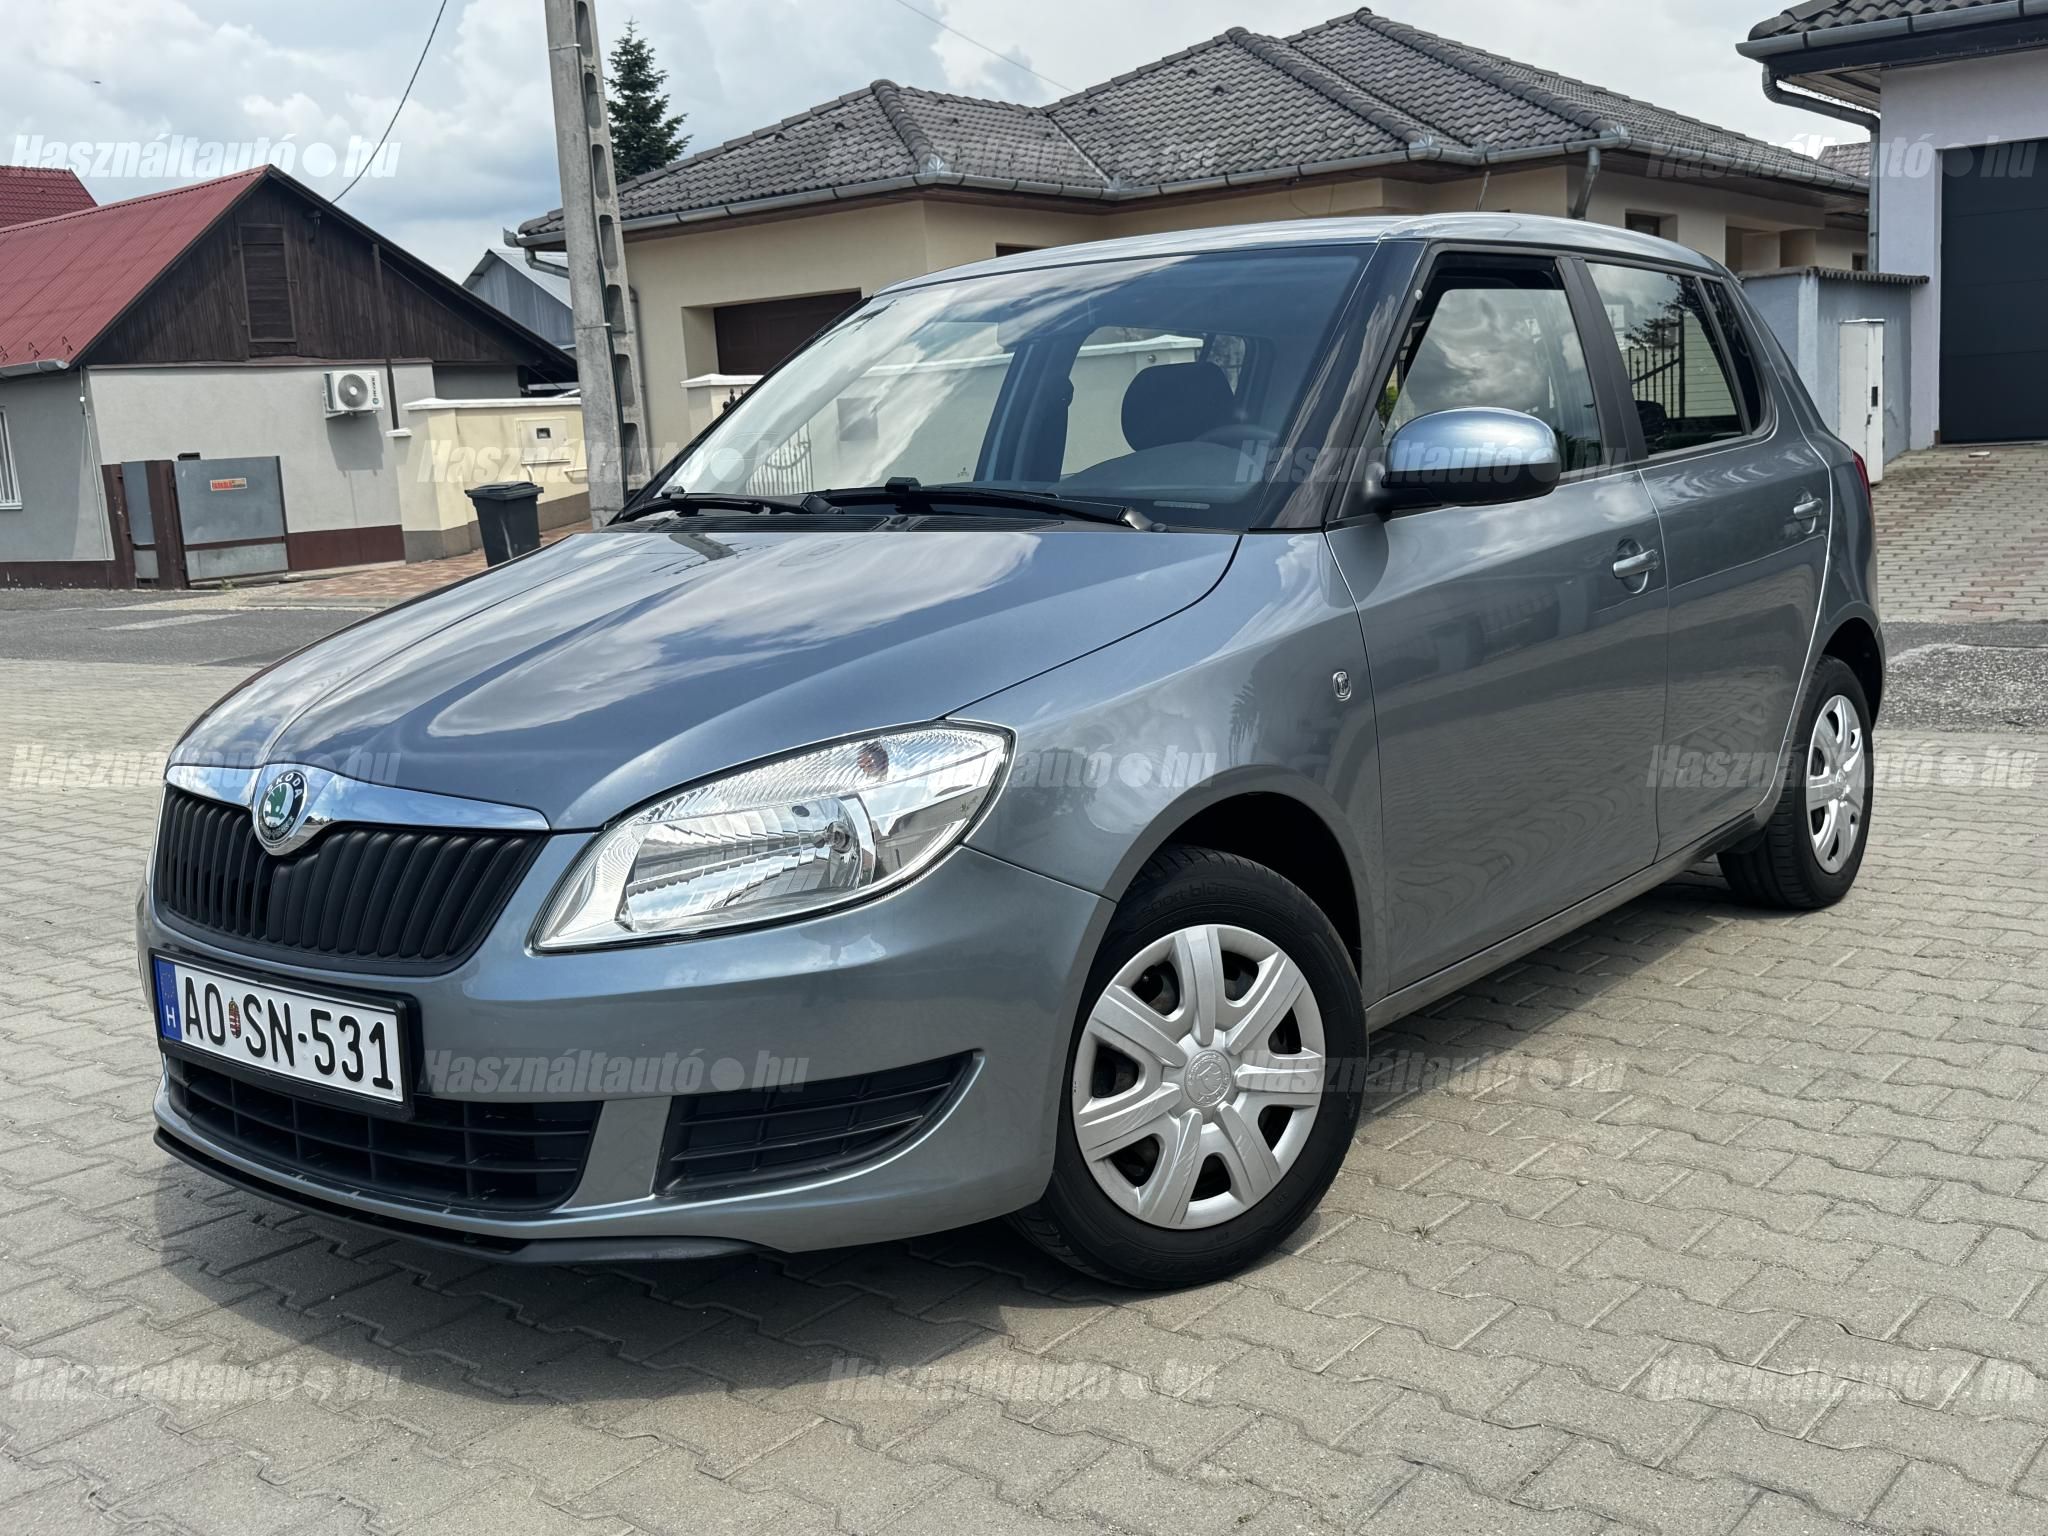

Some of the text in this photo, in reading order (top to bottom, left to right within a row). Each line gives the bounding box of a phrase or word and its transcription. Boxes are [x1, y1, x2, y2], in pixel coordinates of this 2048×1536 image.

[165, 1004, 178, 1029] H
[185, 976, 394, 1090] AO SN-531
